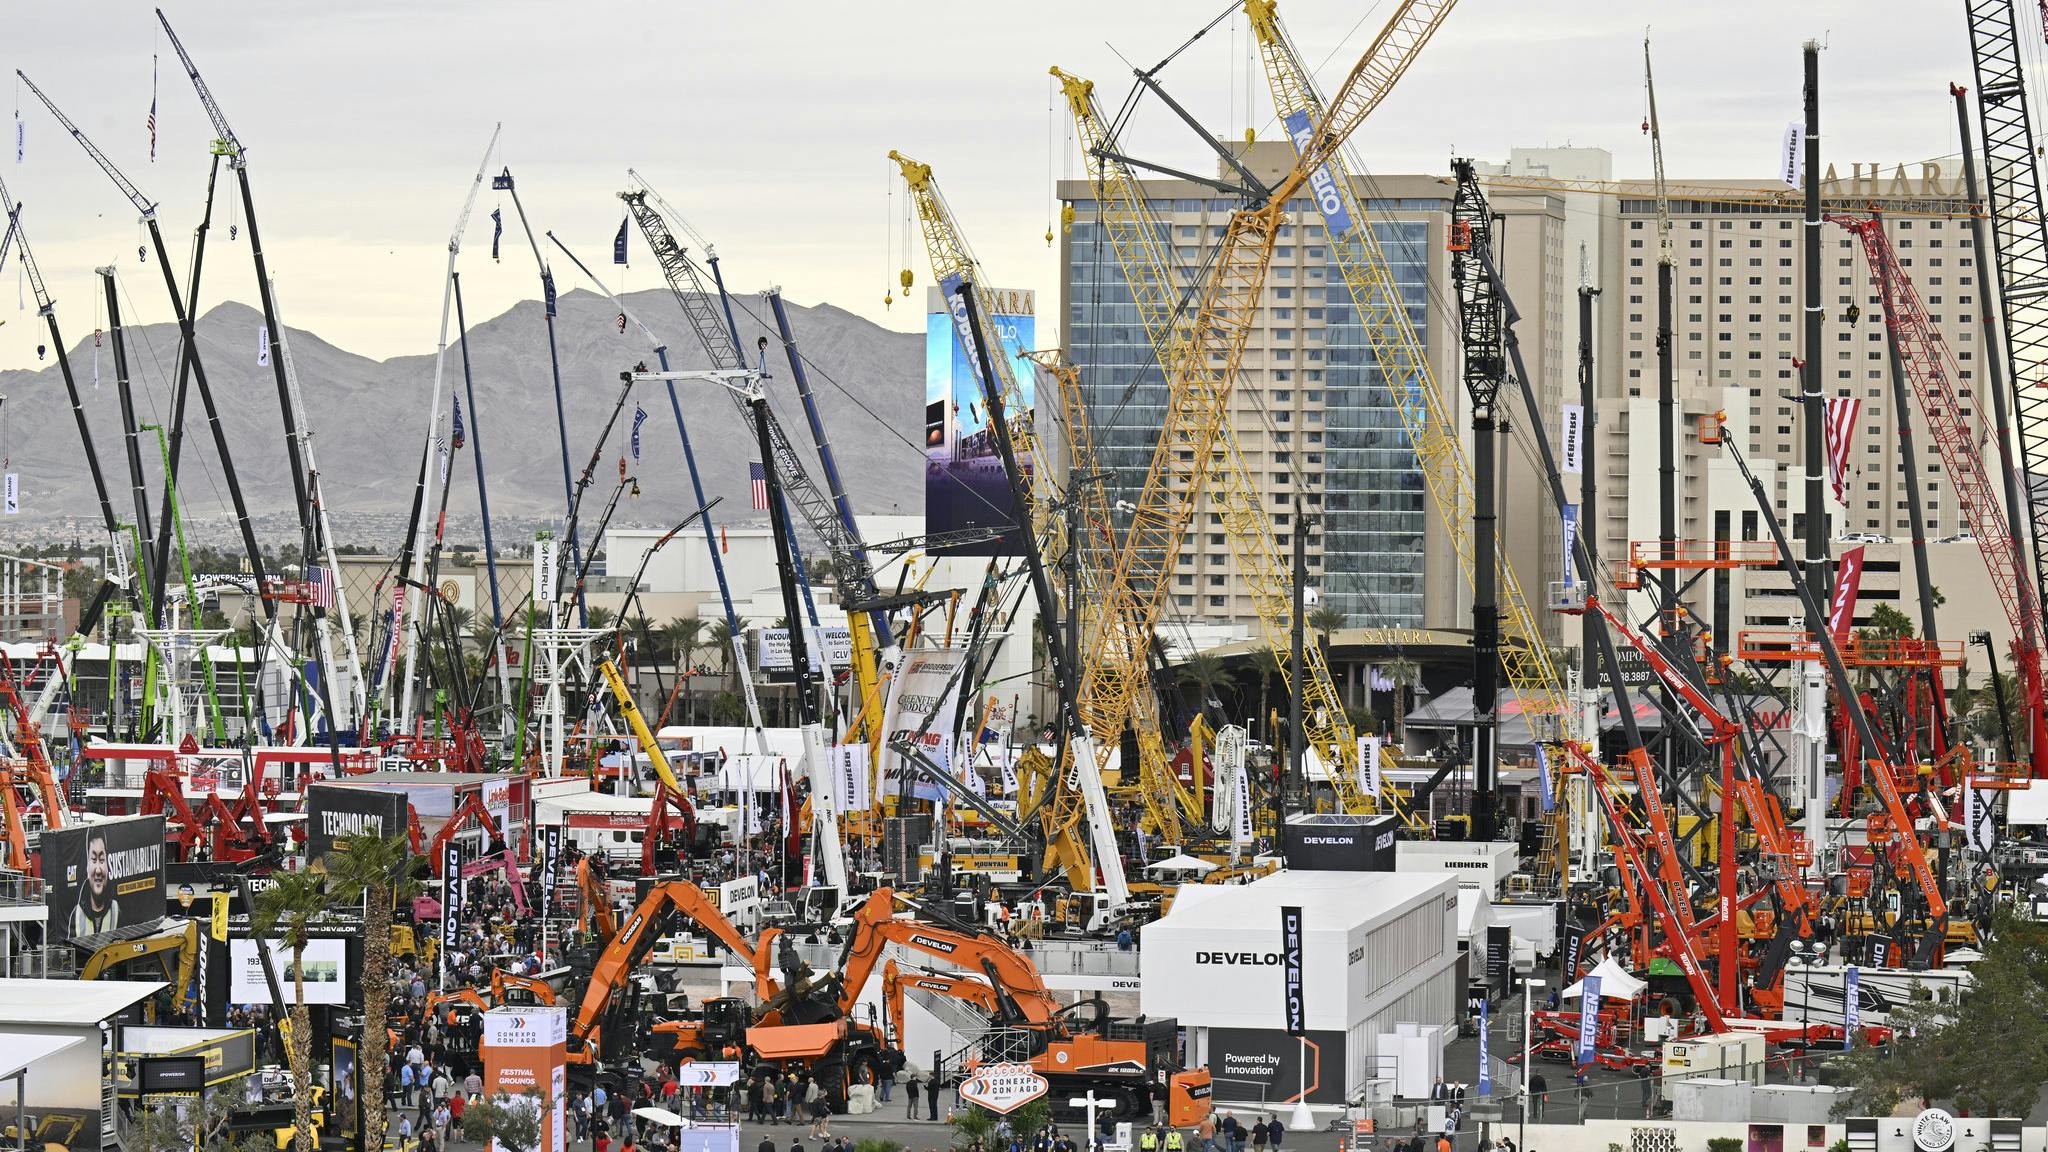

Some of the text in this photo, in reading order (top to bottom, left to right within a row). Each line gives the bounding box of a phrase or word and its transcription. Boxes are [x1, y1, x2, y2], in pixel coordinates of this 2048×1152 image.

[1801, 162, 1972, 197] AHARA
[1361, 629, 1433, 644] SAHARA
[1663, 668, 1686, 690] TEUPEN
[844, 751, 854, 805] LIEBHERR
[1304, 836, 1353, 845] DEVELON
[1375, 830, 1394, 852] DEVELON
[107, 843, 161, 881] SUSTAINABILITY
[1445, 861, 1488, 869] LIEBHERR
[66, 865, 78, 882] CAT
[446, 849, 458, 947] DEVELON
[729, 885, 756, 904] DEVELON
[622, 915, 643, 944] DOOSAN
[916, 937, 952, 952] DEVELON
[1287, 915, 1301, 1031] DEVELON
[921, 982, 949, 991] DEVELON
[1581, 992, 1599, 1054] TEUPEN
[1674, 1047, 1685, 1056] CAT
[1225, 1053, 1280, 1066] Powered by
[500, 1068, 535, 1076] FESTIVAL
[977, 1066, 1031, 1076] WELCOME
[1225, 1065, 1274, 1076] Innovation
[499, 1077, 536, 1085] GROUNDS
[992, 1077, 1038, 1086] CONEXPO
[1917, 1115, 1930, 1136] WHITE
[1930, 1113, 1950, 1125] CLAW
